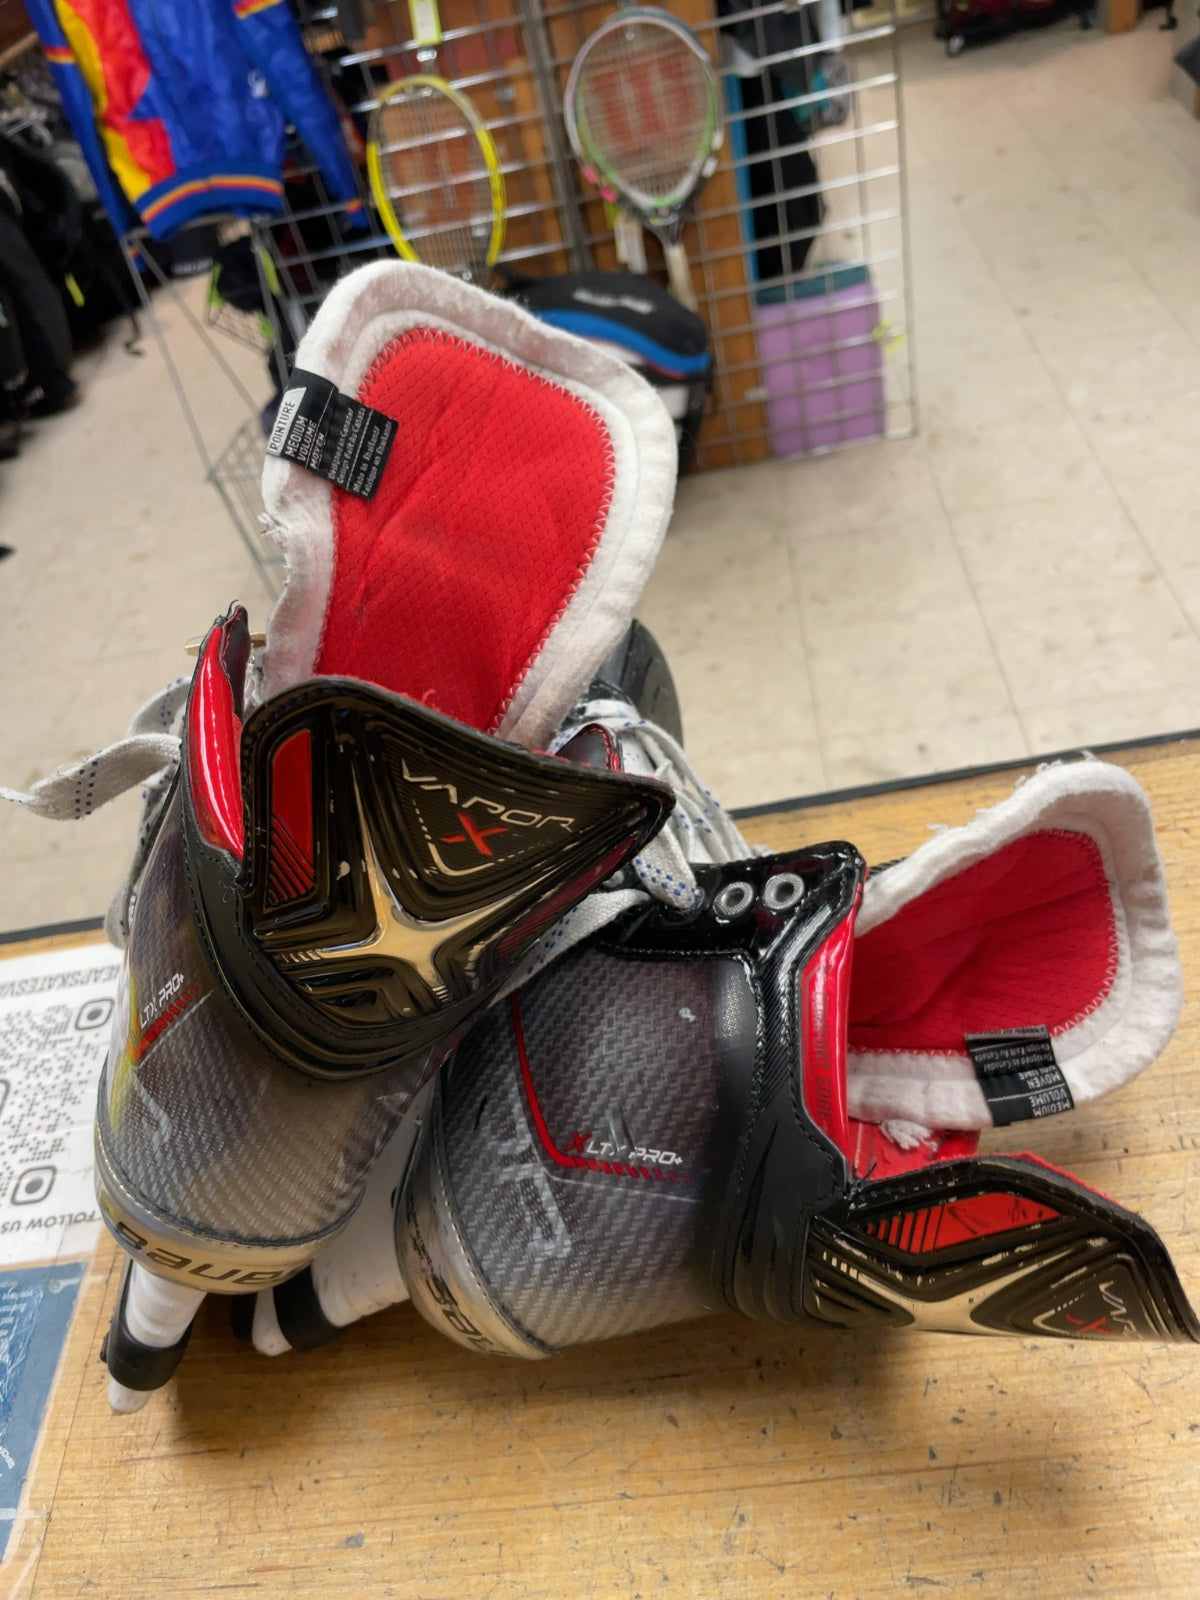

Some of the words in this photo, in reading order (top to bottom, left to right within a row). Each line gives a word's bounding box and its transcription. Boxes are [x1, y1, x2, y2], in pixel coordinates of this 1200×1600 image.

[270, 400, 295, 453] POINTURE
[285, 415, 309, 457] MEDIUM
[297, 420, 317, 461] VOLUME
[310, 432, 325, 468] MOYEN
[328, 447, 343, 479] Designed
[401, 757, 576, 833] VAPOR
[440, 811, 509, 856] X
[1027, 1071, 1061, 1089] MOYEN
[1029, 1088, 1067, 1107] VOLUME
[1032, 1099, 1071, 1118] MEDIUM
[0, 1220, 21, 1234] US
[26, 1210, 95, 1231] FOLLOW
